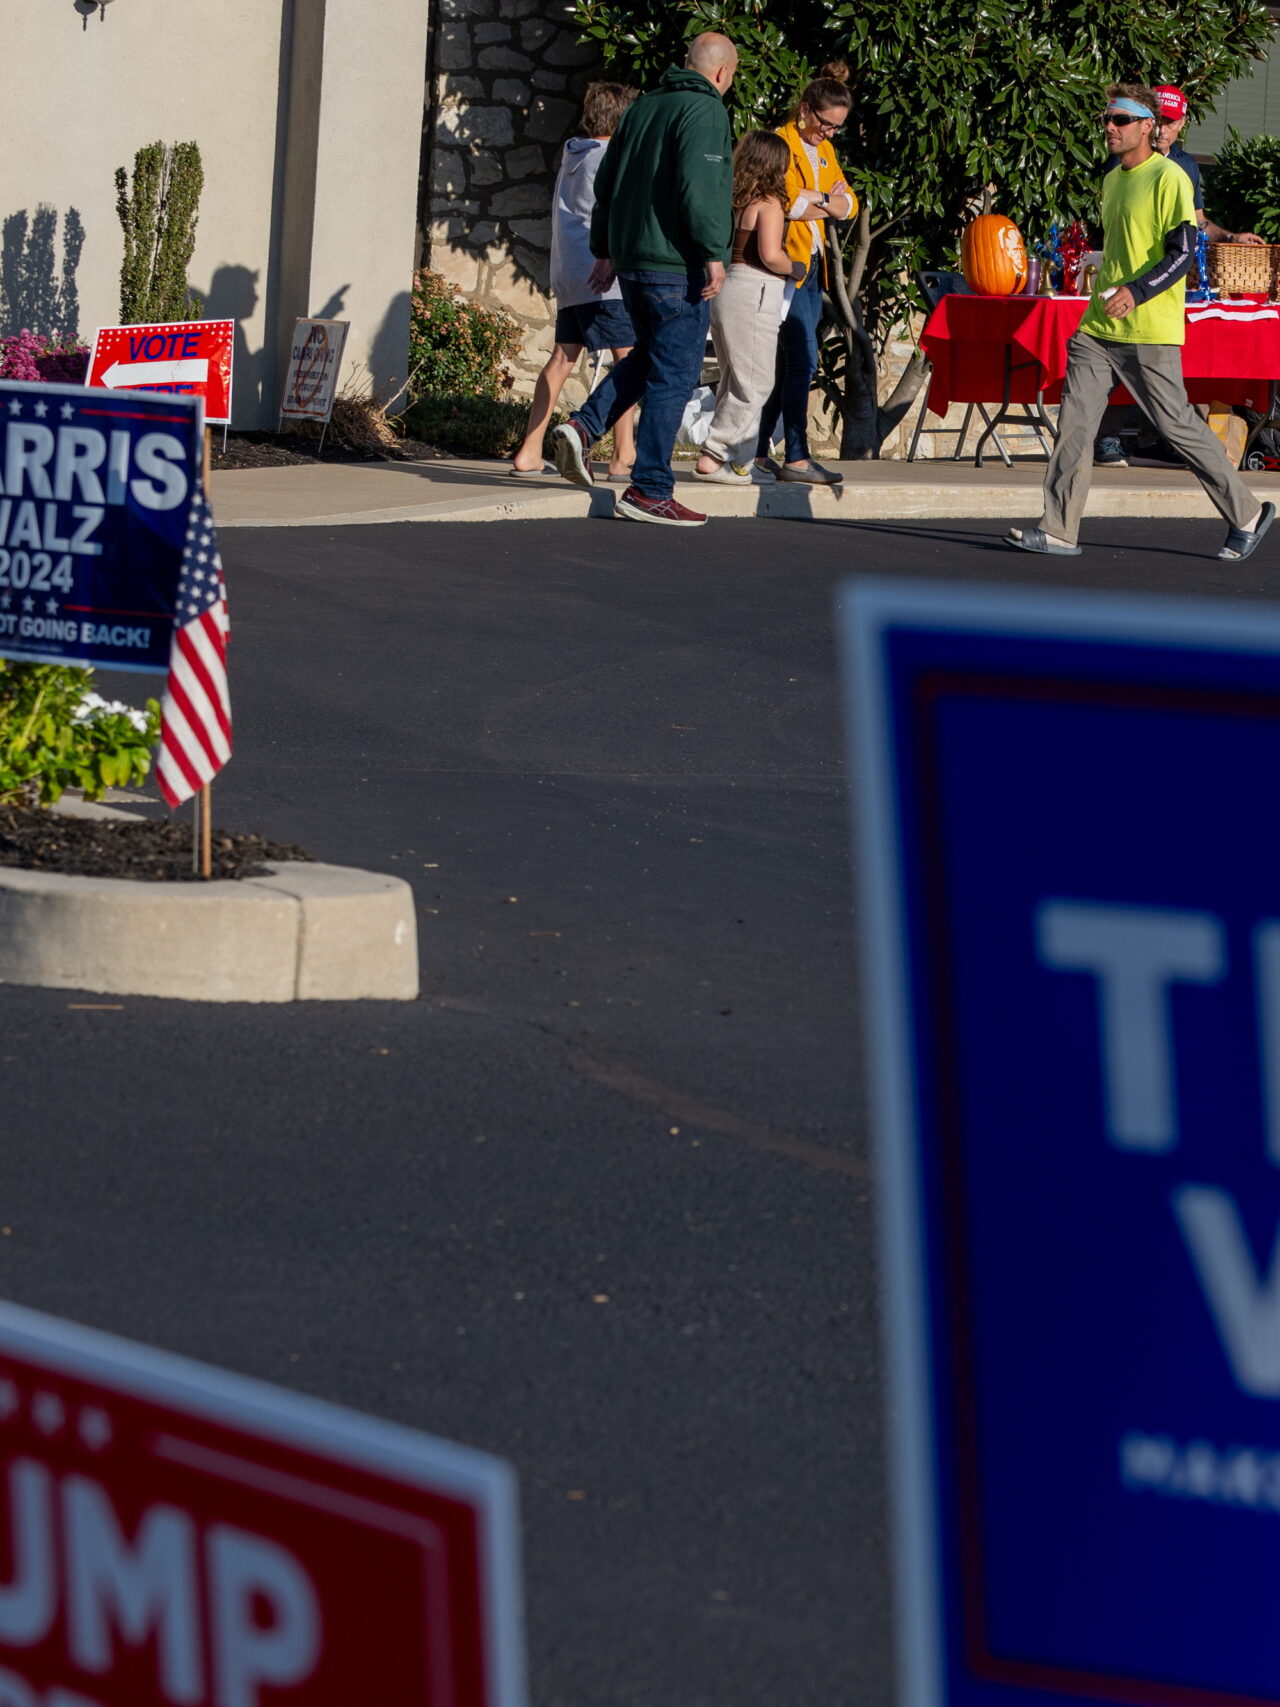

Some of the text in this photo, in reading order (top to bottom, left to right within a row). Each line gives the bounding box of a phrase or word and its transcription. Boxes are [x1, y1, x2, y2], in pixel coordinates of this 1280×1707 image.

[129, 332, 202, 361] VOTE
[0, 421, 188, 511] RRIS
[20, 615, 78, 642] GOING
[81, 621, 151, 649] BACK!
